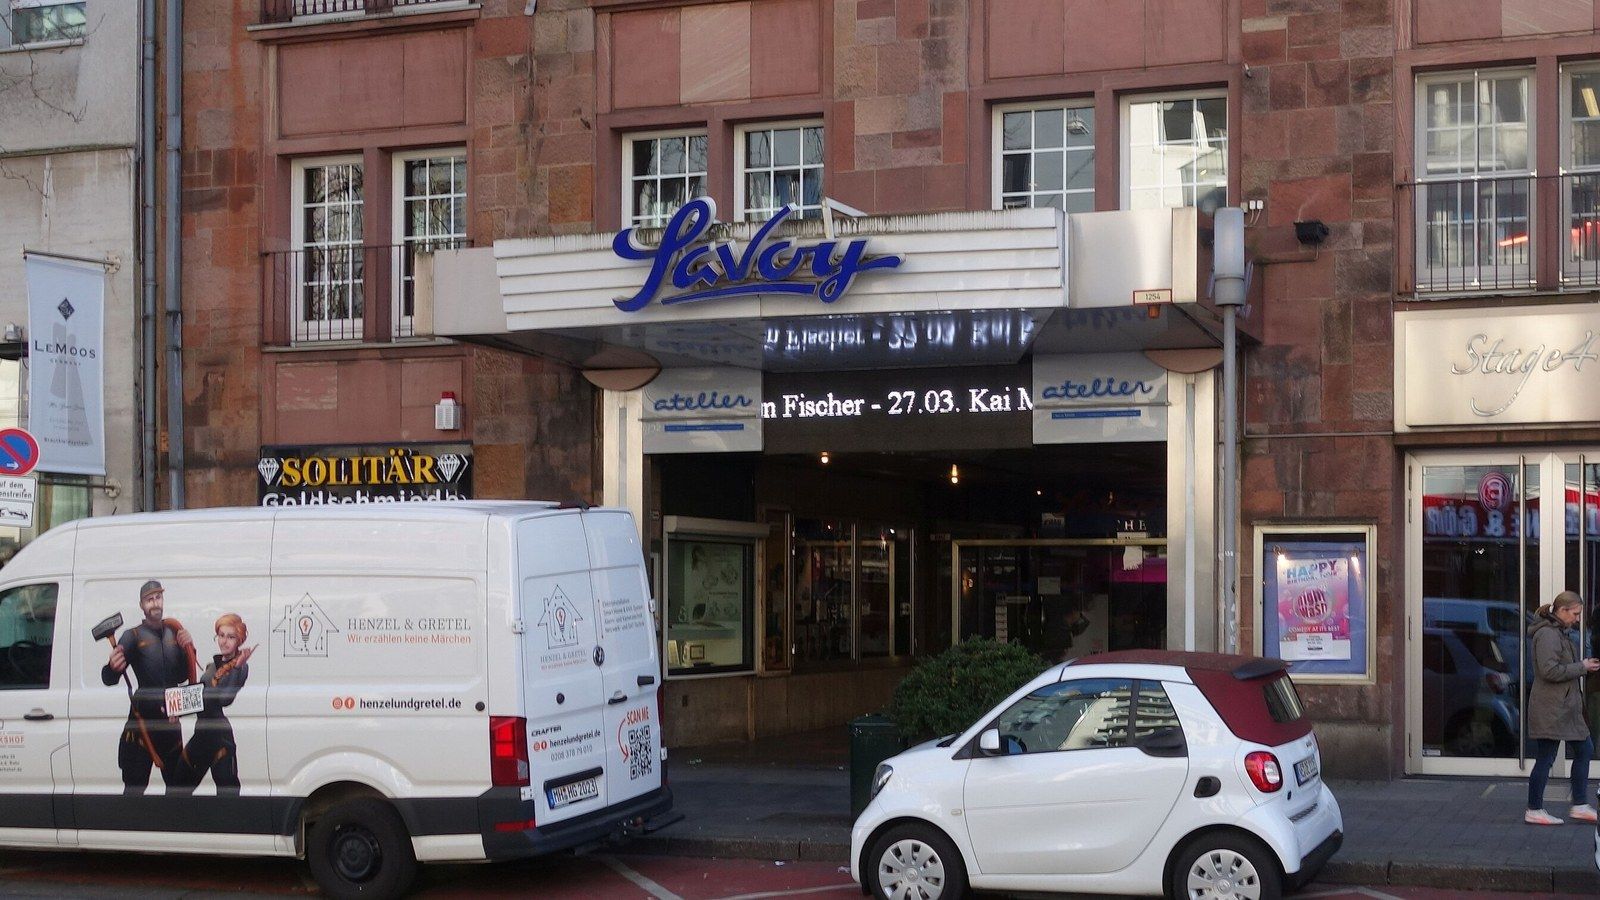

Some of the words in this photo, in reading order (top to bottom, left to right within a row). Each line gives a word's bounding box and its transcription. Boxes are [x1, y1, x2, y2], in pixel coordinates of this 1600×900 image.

[612, 196, 902, 312] Savoy
[1145, 293, 1161, 301] 1254
[1041, 377, 1154, 400] atelier
[653, 391, 753, 412] atelier
[782, 393, 865, 418] Fischer
[887, 389, 961, 416] 27.03.
[968, 387, 1012, 412] Kai
[281, 448, 438, 487] SOLITÄR
[347, 618, 401, 631] HENZEL
[404, 618, 414, 631] &
[418, 618, 472, 631] GRETEL
[346, 634, 362, 644] Wir
[364, 633, 401, 644] erzählen
[404, 633, 430, 644] keine
[431, 633, 471, 644] Märchen
[169, 699, 183, 712] ME
[360, 698, 463, 711] henzelundgretel.de
[626, 709, 642, 726] SCAN
[641, 705, 650, 722] ME
[531, 725, 562, 738] CRAFTER
[549, 728, 601, 749] henzelundgretel.de
[552, 786, 565, 803] MH
[577, 778, 597, 797] 2023
